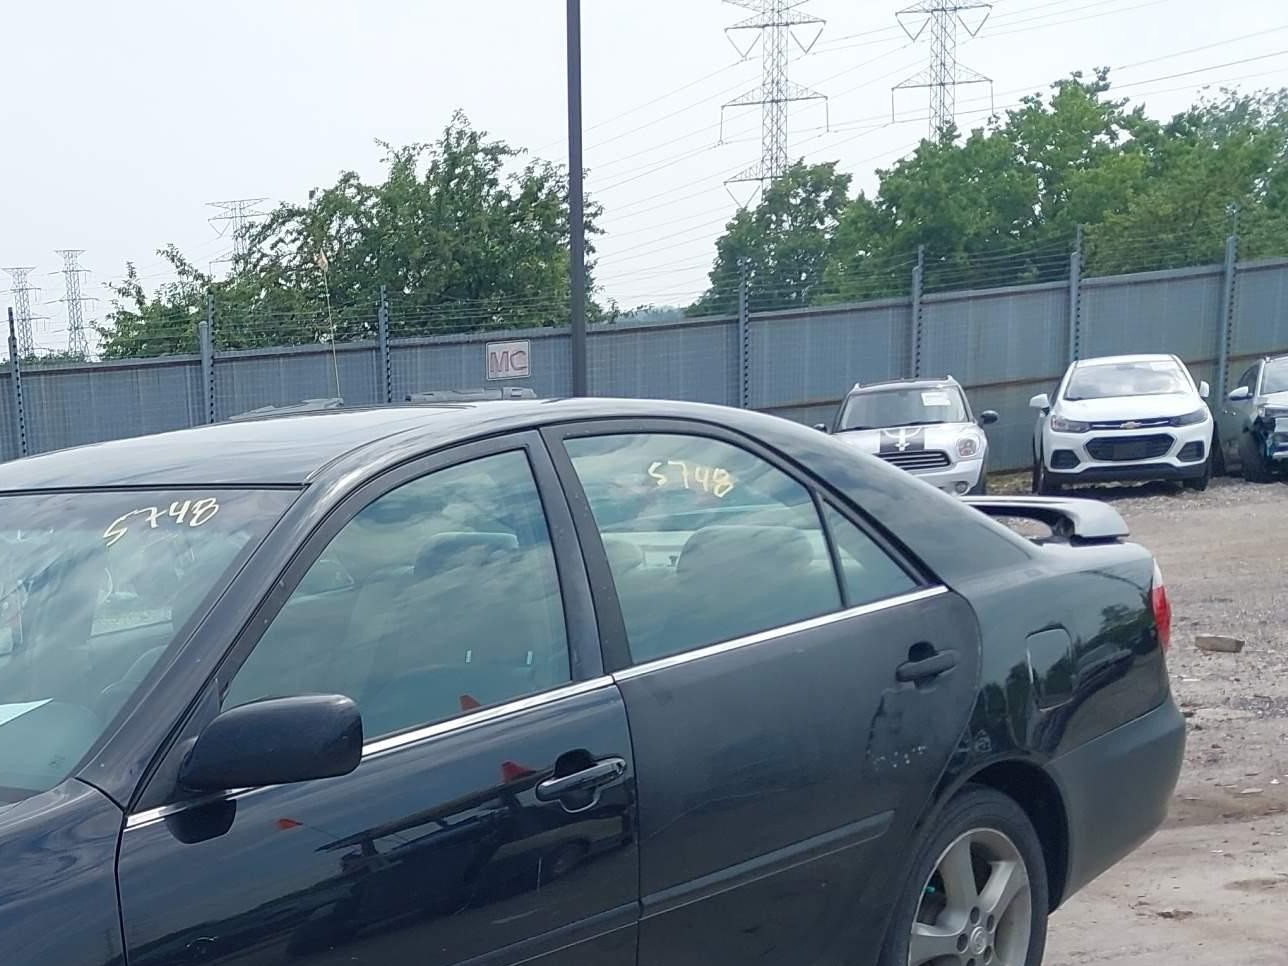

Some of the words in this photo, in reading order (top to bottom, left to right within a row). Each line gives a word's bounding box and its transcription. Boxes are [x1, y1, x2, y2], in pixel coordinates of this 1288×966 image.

[490, 350, 528, 373] MC
[648, 460, 734, 498] 5748
[103, 497, 220, 547] 5748
